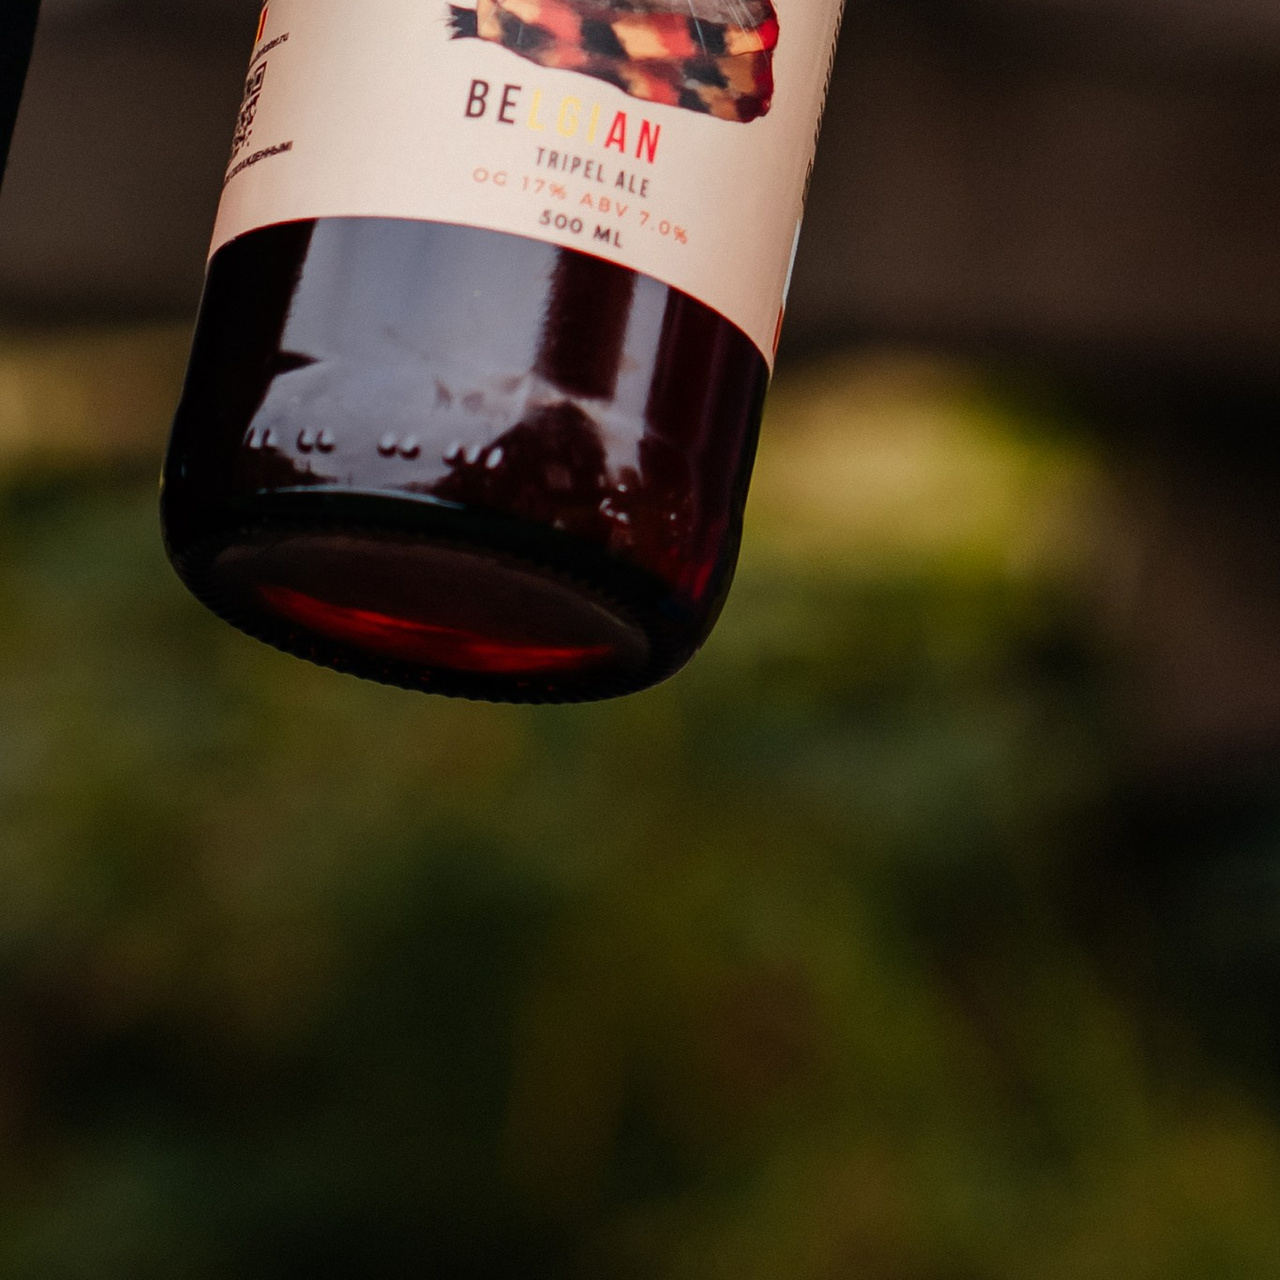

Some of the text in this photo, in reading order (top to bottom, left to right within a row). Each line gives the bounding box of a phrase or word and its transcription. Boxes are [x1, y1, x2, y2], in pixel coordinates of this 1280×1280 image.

[464, 79, 661, 164] BELGIAN
[536, 147, 650, 198] TRIPEL ALE
[472, 167, 688, 245] OG 17% ABV 7.0%
[539, 209, 623, 248] 500 ML
